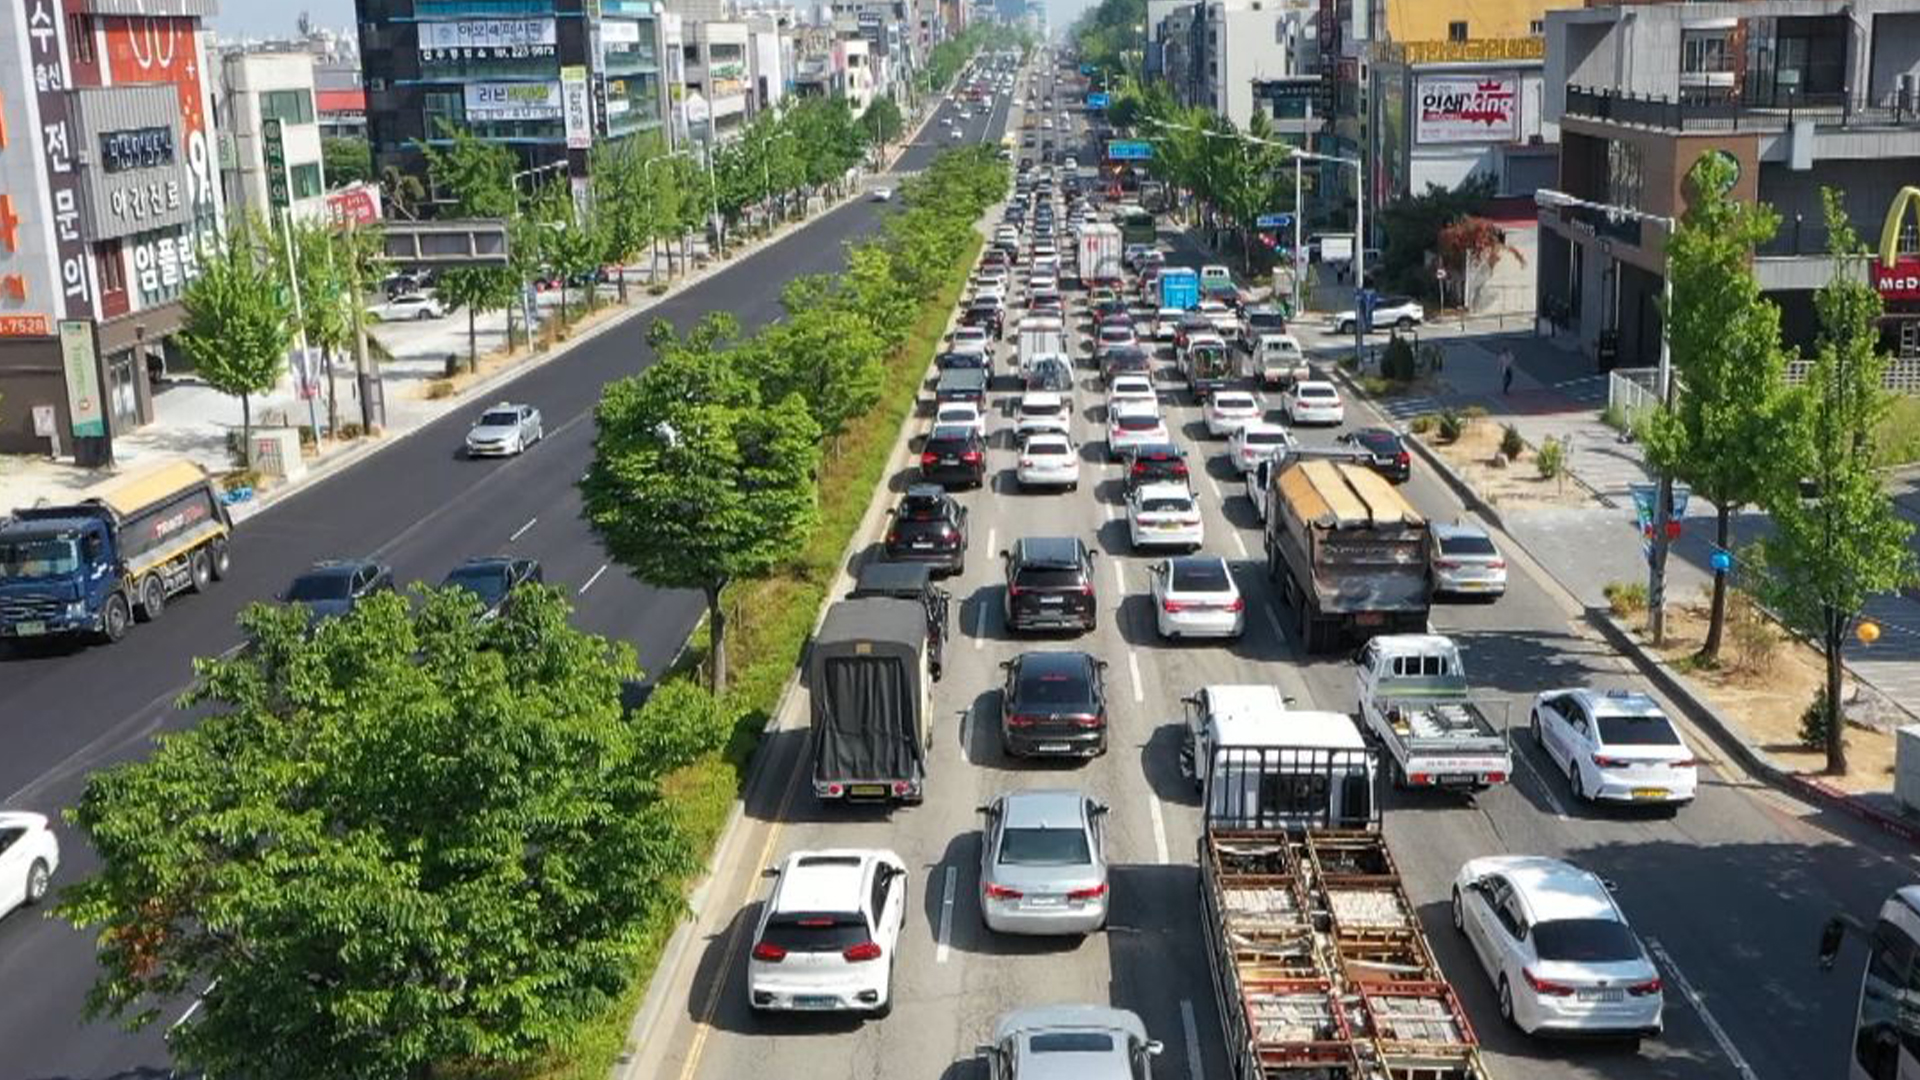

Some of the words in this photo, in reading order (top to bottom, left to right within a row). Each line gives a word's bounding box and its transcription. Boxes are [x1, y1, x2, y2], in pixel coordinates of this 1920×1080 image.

[30, 1, 54, 53] 수
[35, 63, 62, 92] 출신
[45, 120, 89, 303] 전문의
[112, 181, 181, 219] 야간진료
[1880, 277, 1920, 290] McD
